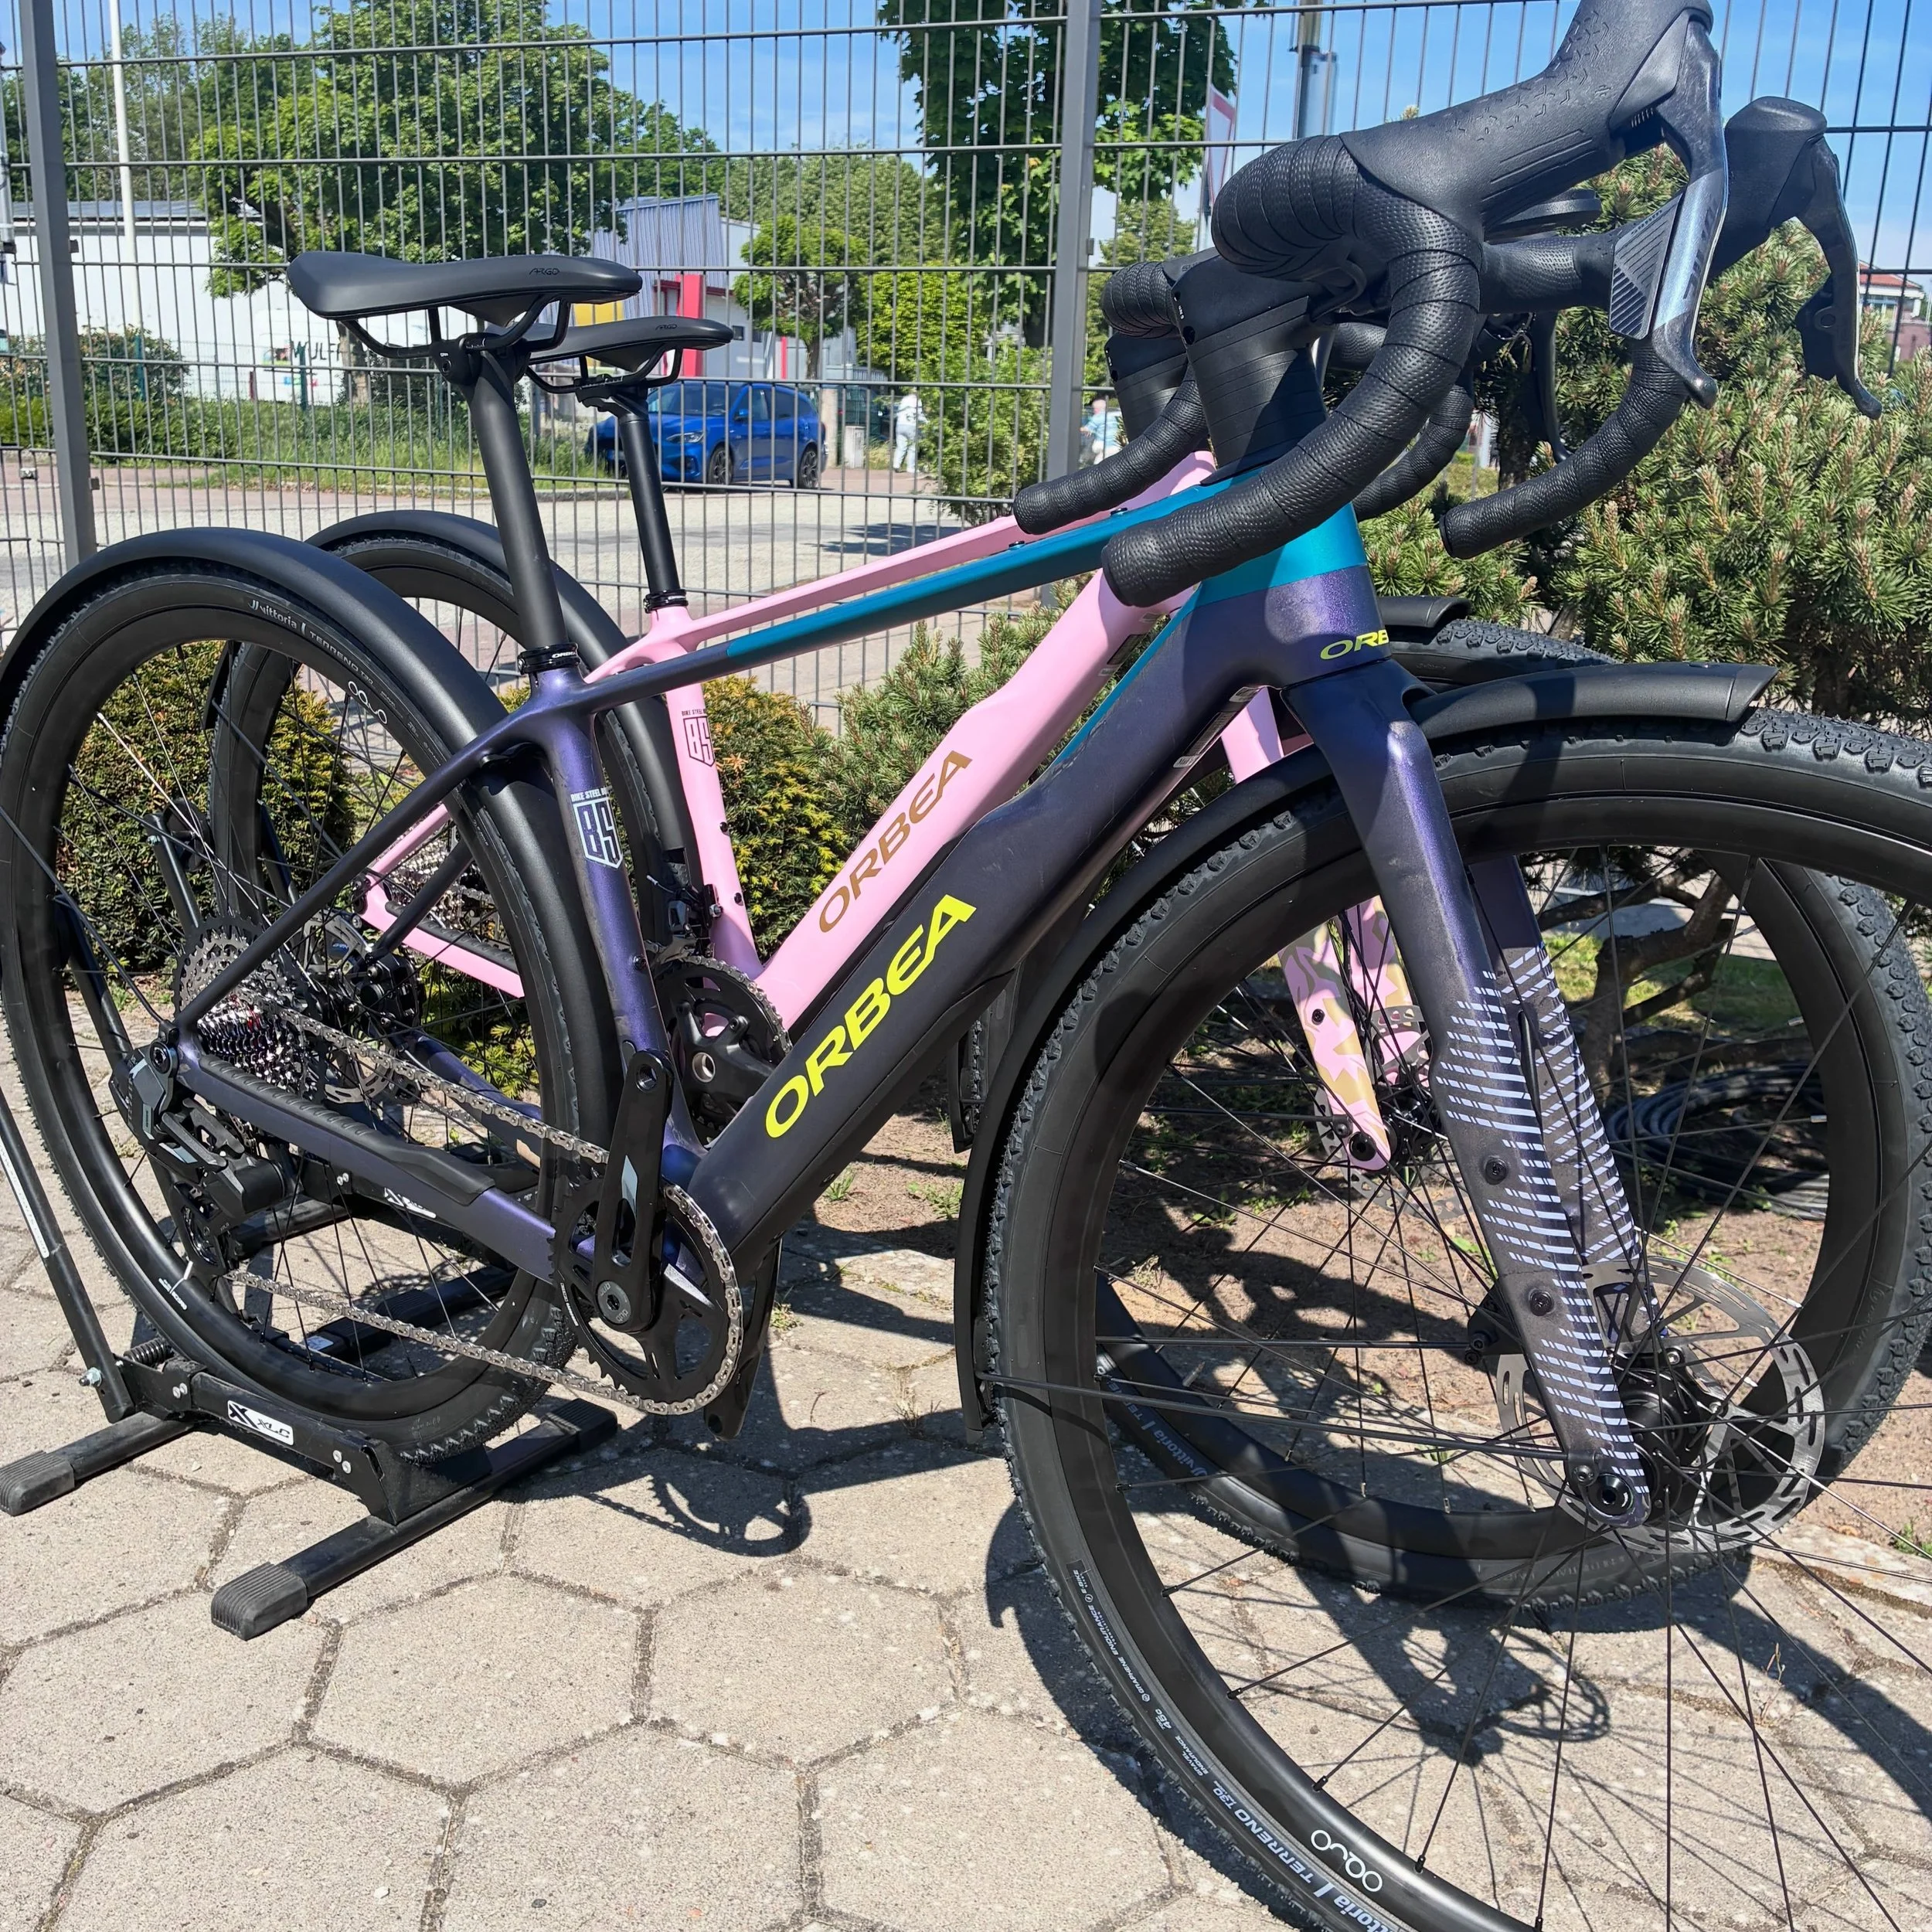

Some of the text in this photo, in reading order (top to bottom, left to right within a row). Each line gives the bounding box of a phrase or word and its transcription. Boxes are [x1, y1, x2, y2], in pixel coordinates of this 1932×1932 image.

[260, 605, 298, 629] vittoria
[309, 631, 359, 672] TERRENO
[570, 792, 585, 802] BIKE
[585, 788, 601, 799] STEEL
[819, 750, 973, 933] ORBEA
[766, 894, 977, 1138] ORBEA
[257, 1418, 291, 1438] XLC
[1154, 1430, 1195, 1468] vittoria
[1073, 1570, 1087, 1594] E-BIKE
[1088, 1604, 1145, 1695] GRAPHENE ENDURANCE
[1175, 1735, 1209, 1775] ENDURANCE
[1182, 1750, 1203, 1776] GRAVEL
[1213, 1787, 1236, 1809] T30
[1234, 1809, 1314, 1884] TERRENO
[1334, 1895, 1393, 1932] ttoria
